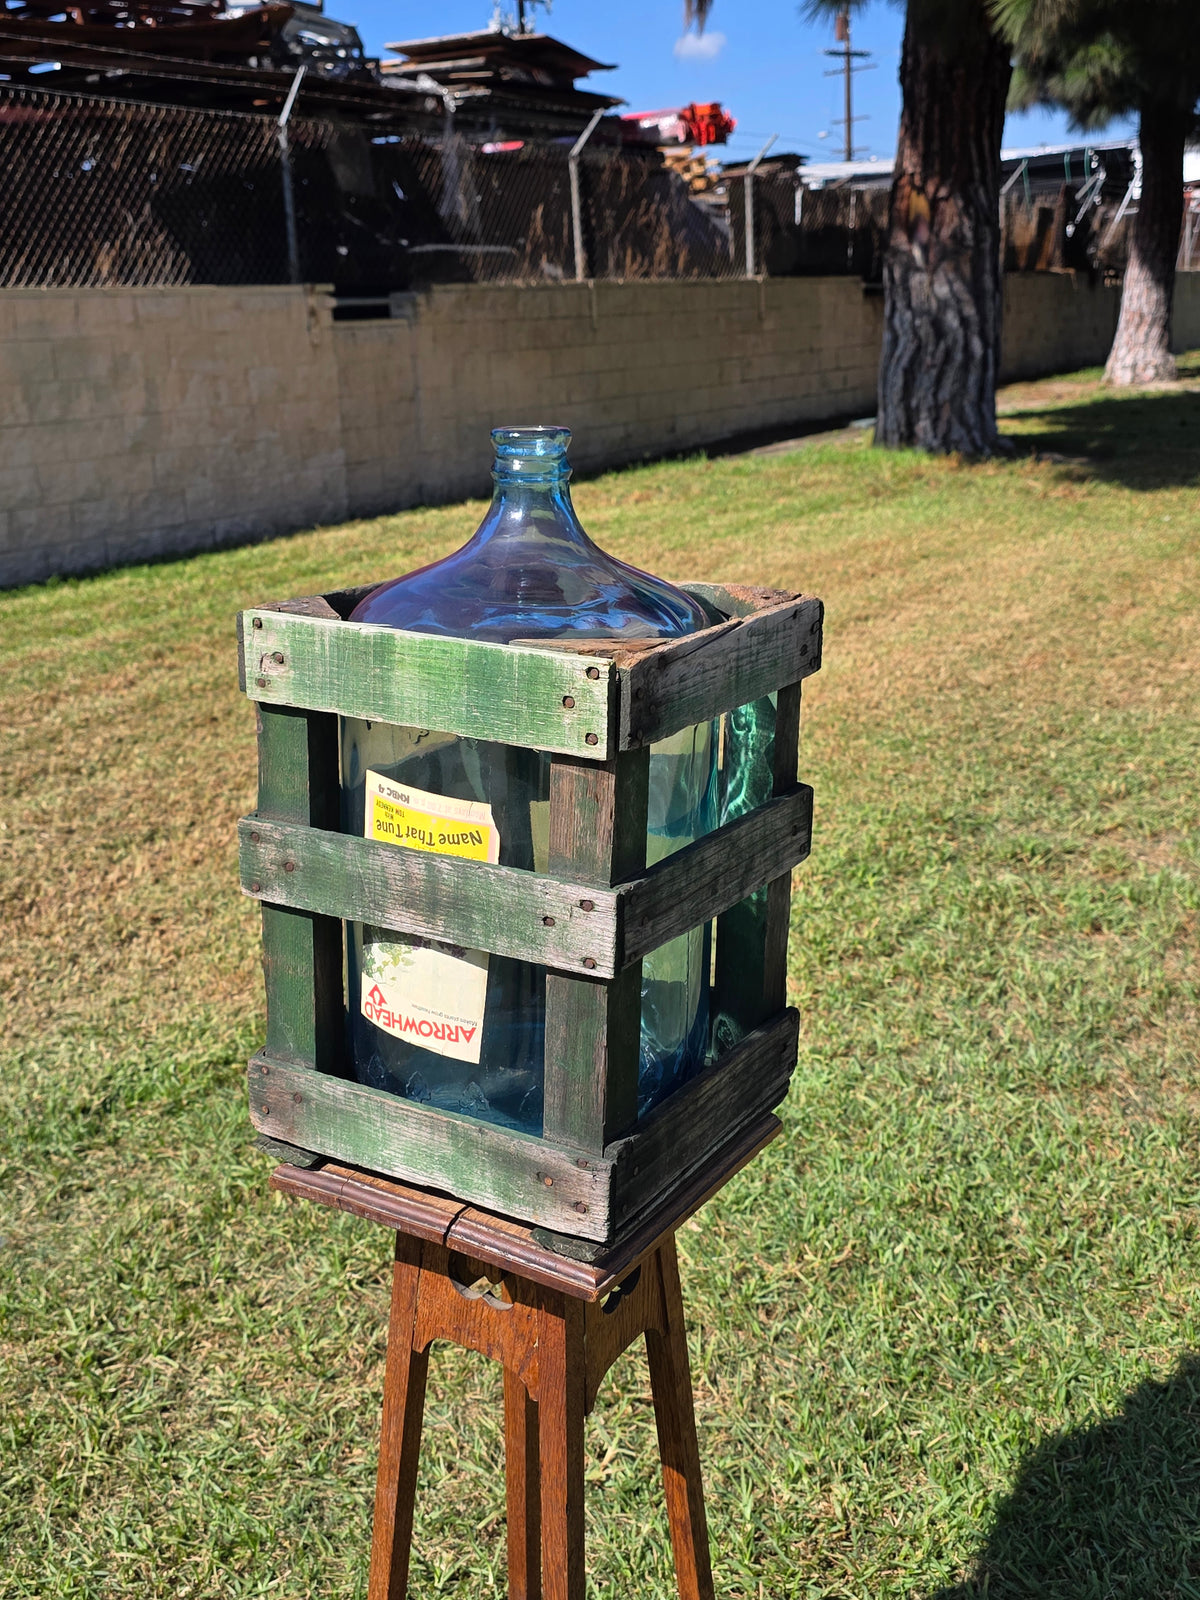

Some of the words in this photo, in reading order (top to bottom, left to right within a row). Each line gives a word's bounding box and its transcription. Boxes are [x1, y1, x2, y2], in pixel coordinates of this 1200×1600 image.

[378, 783, 385, 794] 4
[386, 787, 410, 804] KNBC
[395, 807, 405, 818] TOM
[376, 819, 404, 838] Tune
[406, 826, 436, 846] That
[438, 830, 483, 846] Name
[364, 1001, 477, 1044] ARROWHEAD
